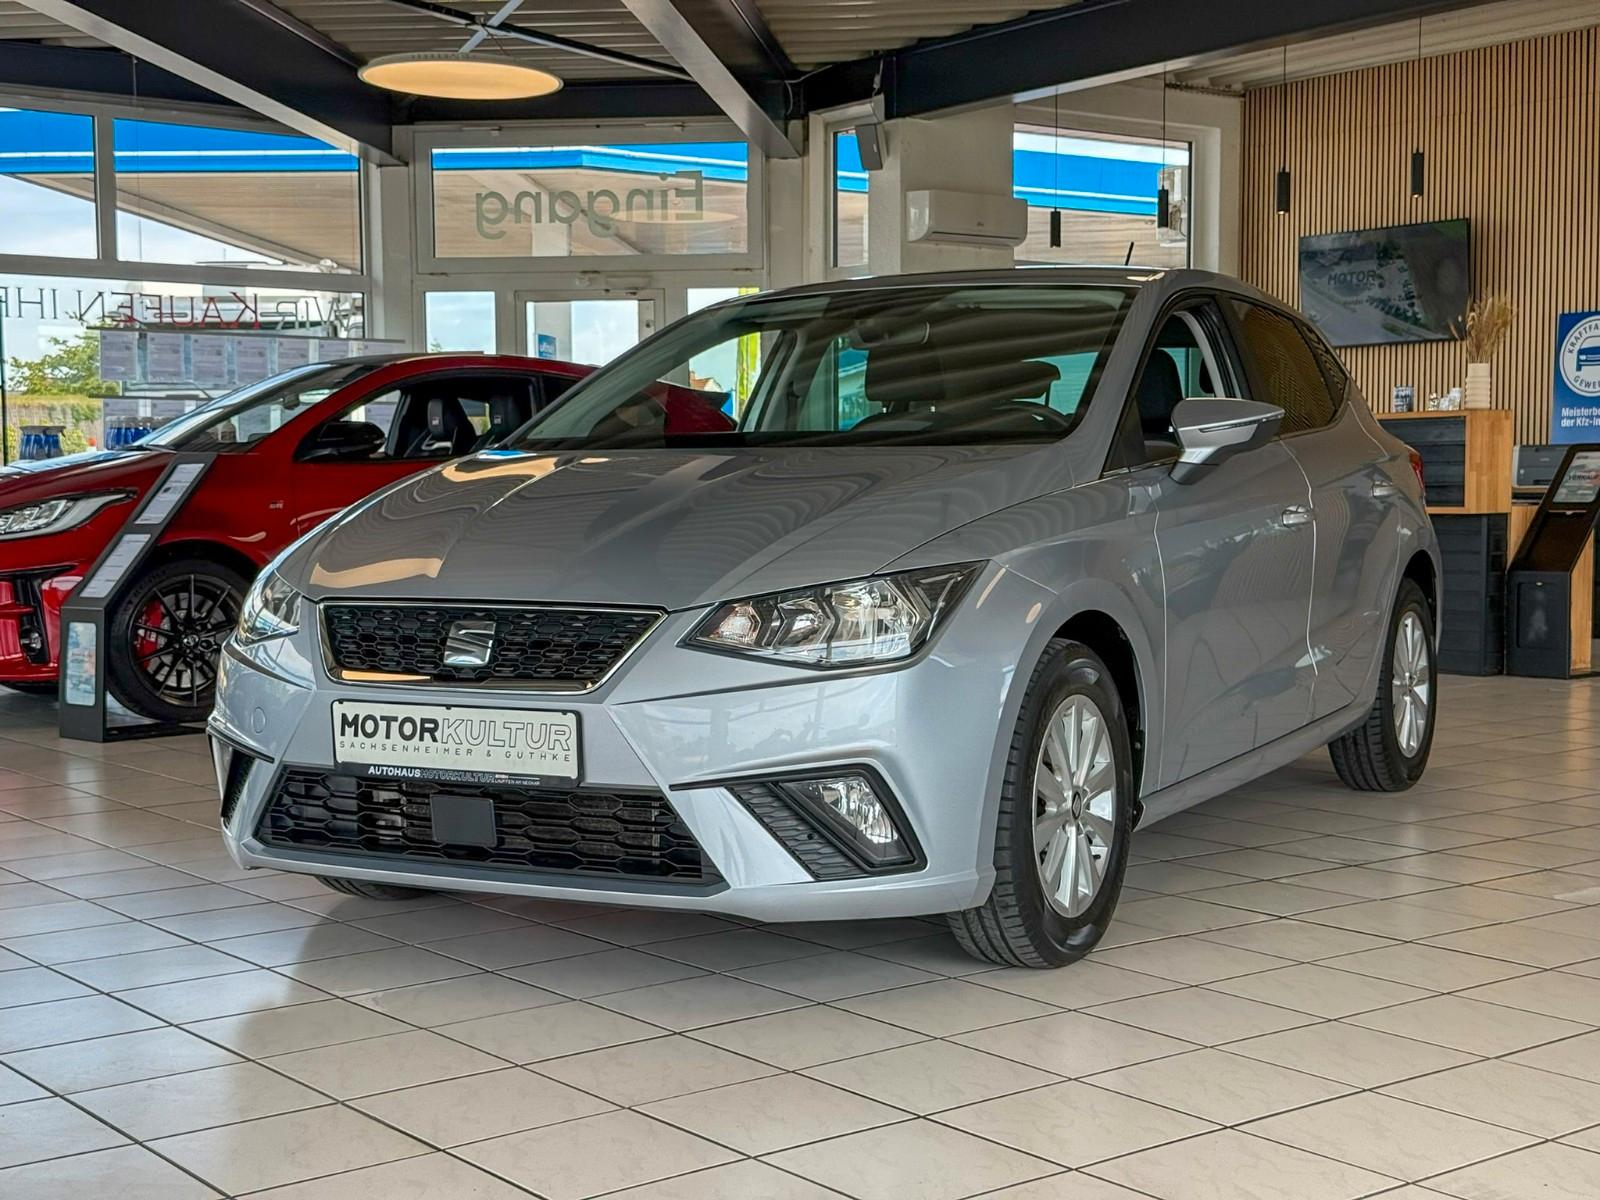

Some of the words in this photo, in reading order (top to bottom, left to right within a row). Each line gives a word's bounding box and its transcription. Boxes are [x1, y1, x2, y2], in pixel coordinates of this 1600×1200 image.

[1561, 418, 1575, 428] der
[339, 740, 473, 757] SACHSENHEIMER
[486, 750, 493, 758] &
[505, 751, 571, 762] GUTHKE
